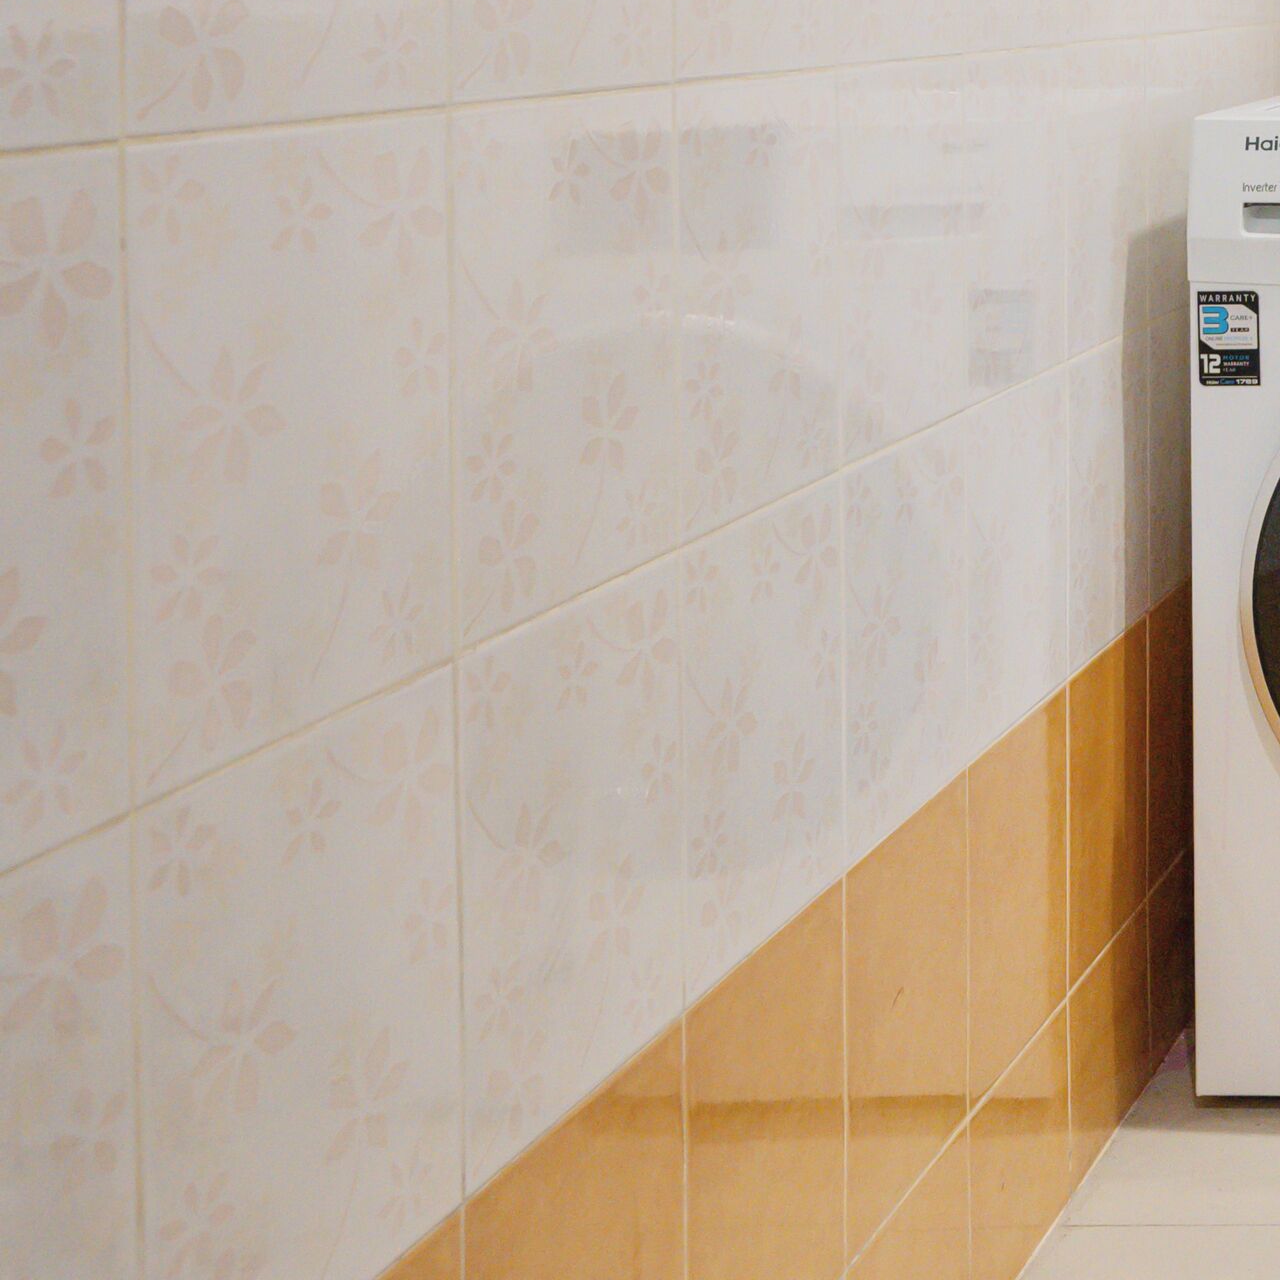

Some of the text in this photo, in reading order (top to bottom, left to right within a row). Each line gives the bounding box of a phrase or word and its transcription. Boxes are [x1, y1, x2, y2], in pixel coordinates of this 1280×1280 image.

[1242, 182, 1277, 193] Inverter
[1200, 294, 1256, 302] WARRANTY
[1202, 306, 1229, 334] 3
[1200, 353, 1222, 374] 12
